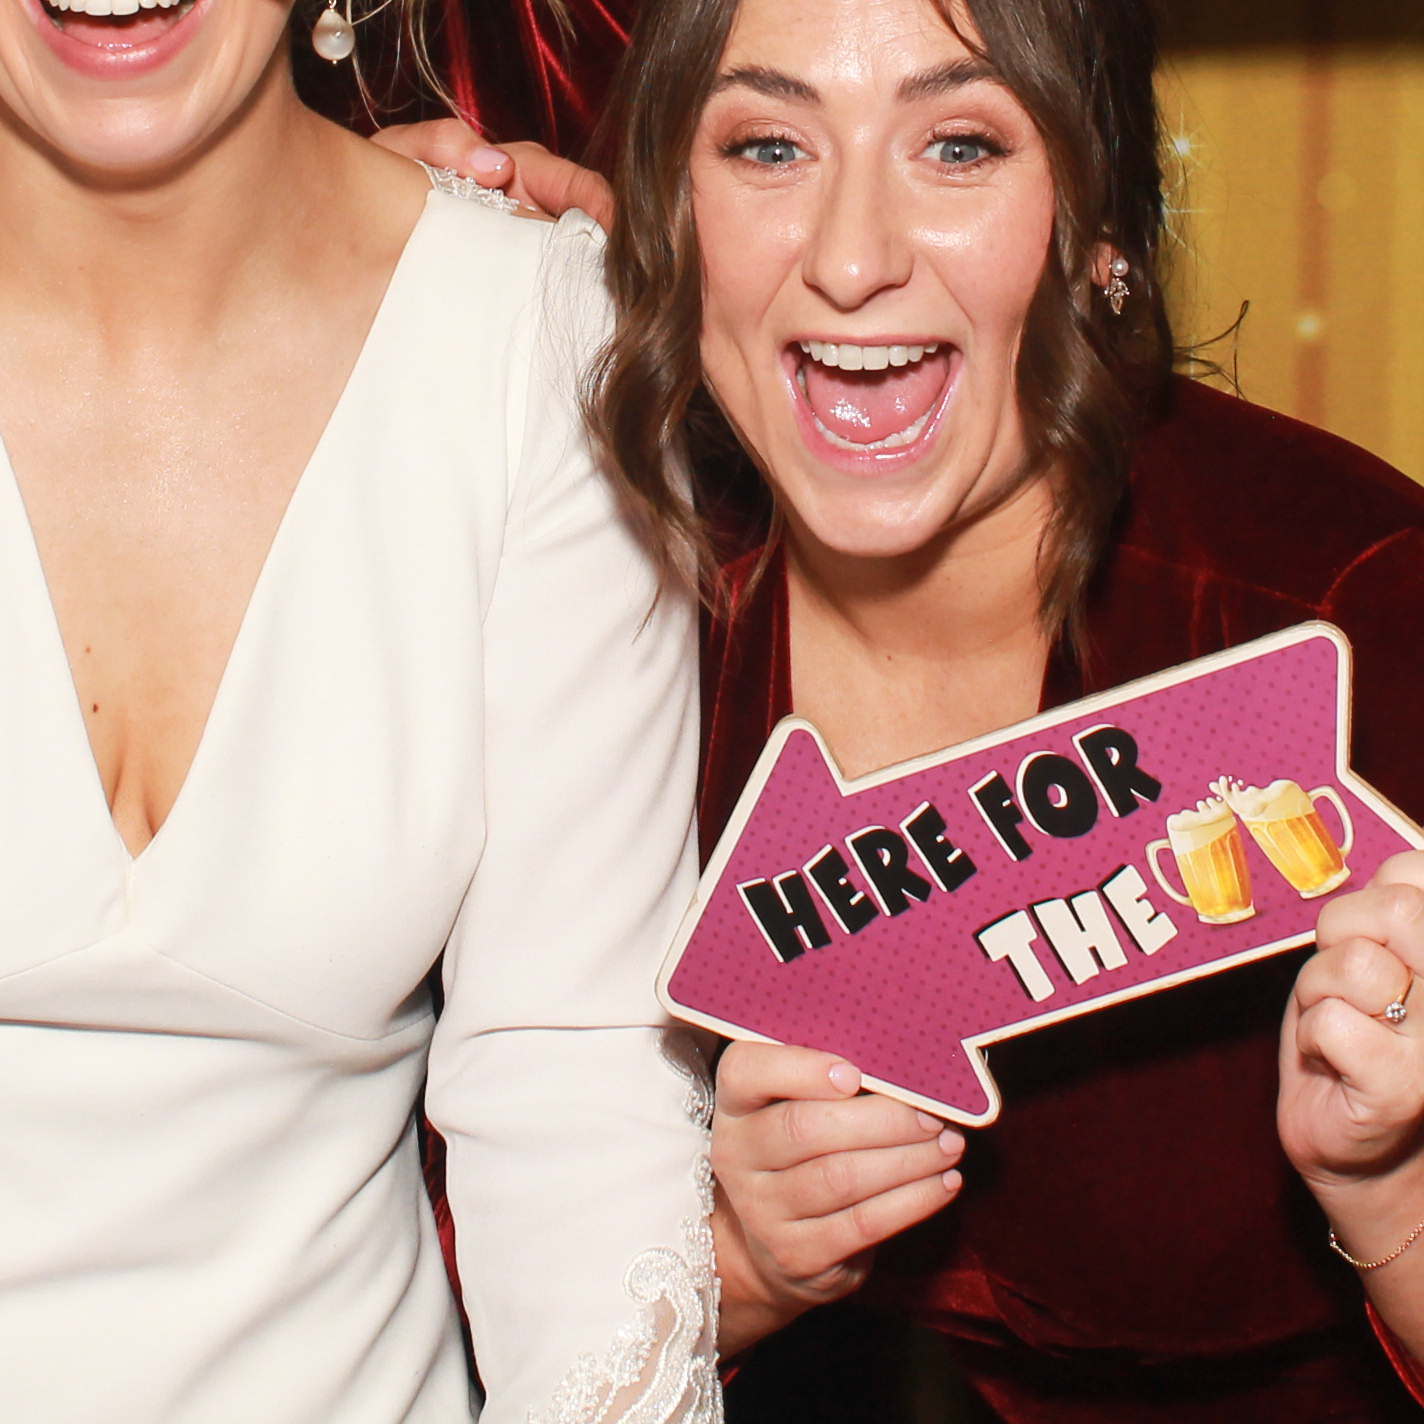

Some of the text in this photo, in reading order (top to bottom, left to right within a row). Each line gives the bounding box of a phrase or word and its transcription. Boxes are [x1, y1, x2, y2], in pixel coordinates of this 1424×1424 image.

[737, 724, 1163, 964] HERE FOR
[975, 864, 1178, 1003] THE
